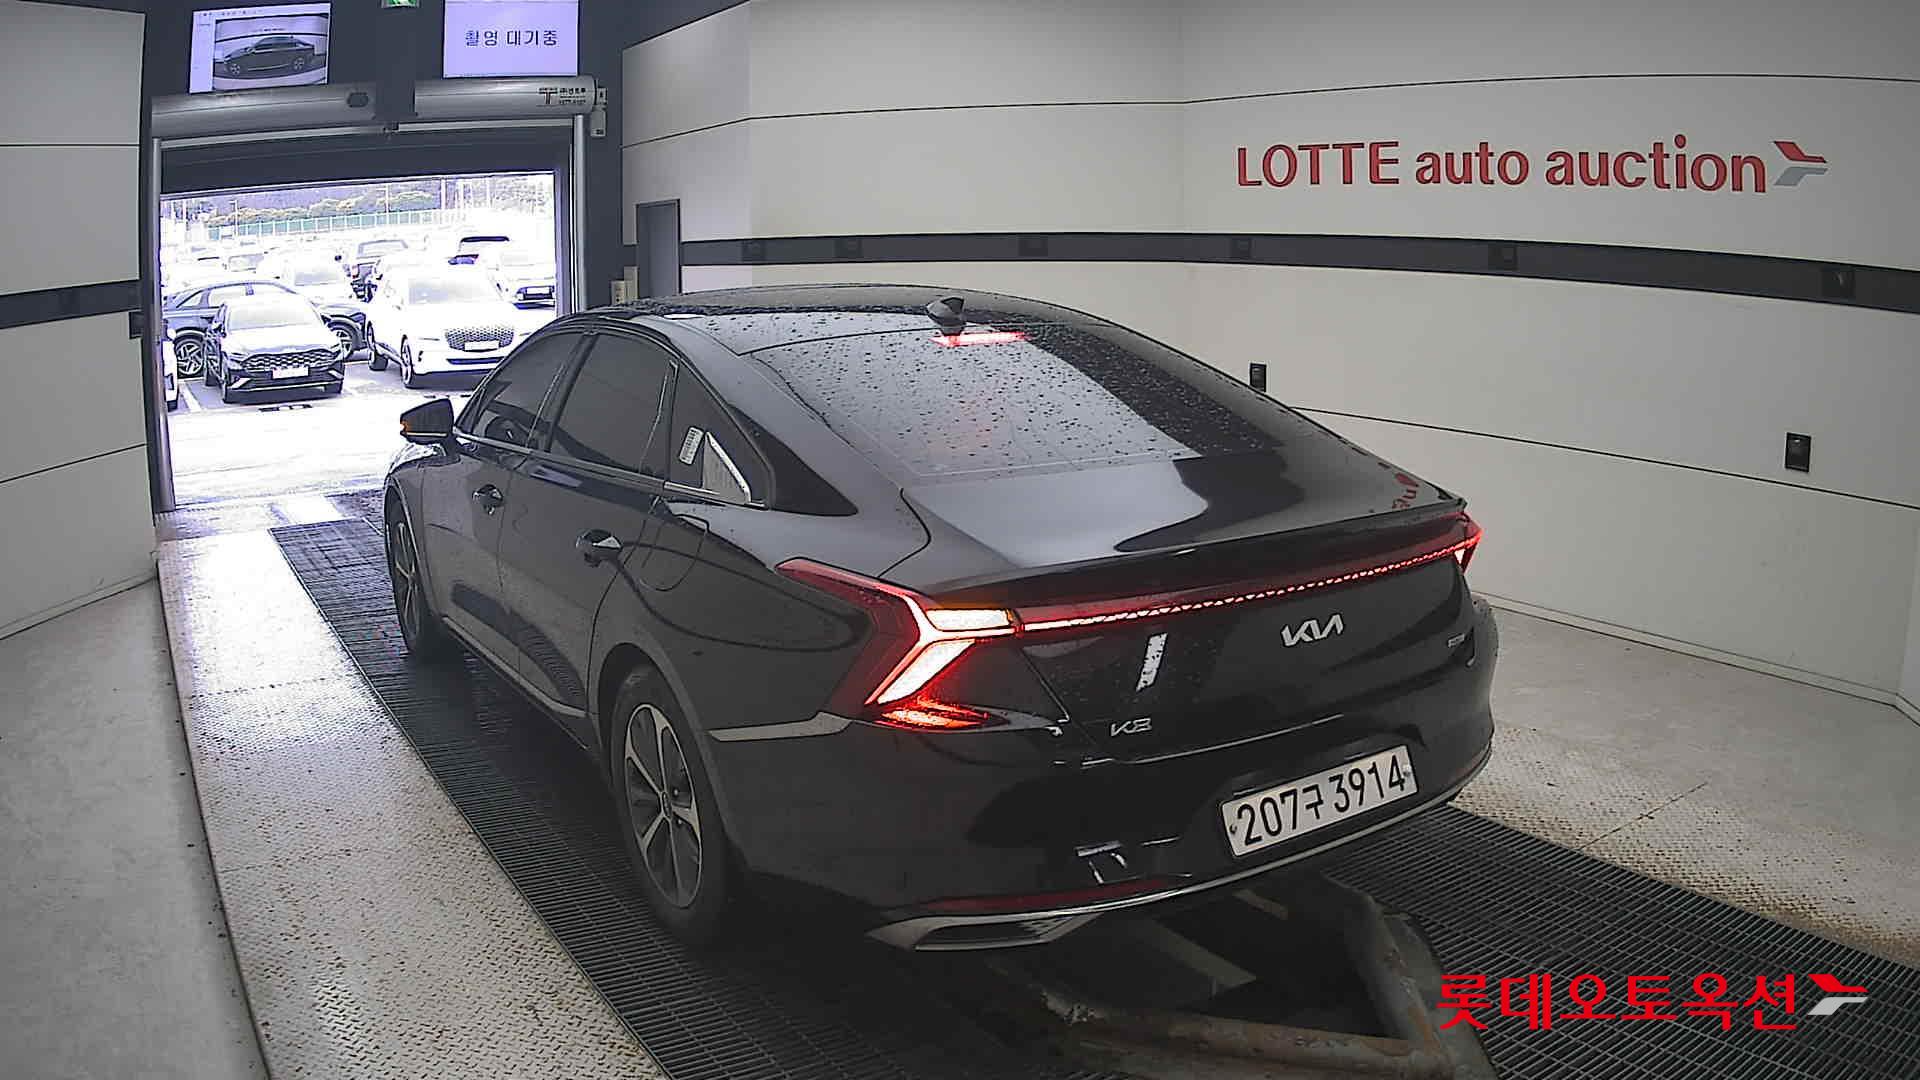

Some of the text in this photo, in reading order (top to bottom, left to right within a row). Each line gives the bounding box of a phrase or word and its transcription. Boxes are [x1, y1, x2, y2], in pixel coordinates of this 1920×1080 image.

[507, 29, 557, 47] 대기중
[1236, 133, 1766, 193] LOTTE auto auction
[1281, 613, 1345, 647] KIA
[1109, 717, 1153, 737] K8
[1236, 753, 1408, 848] 207구 3914
